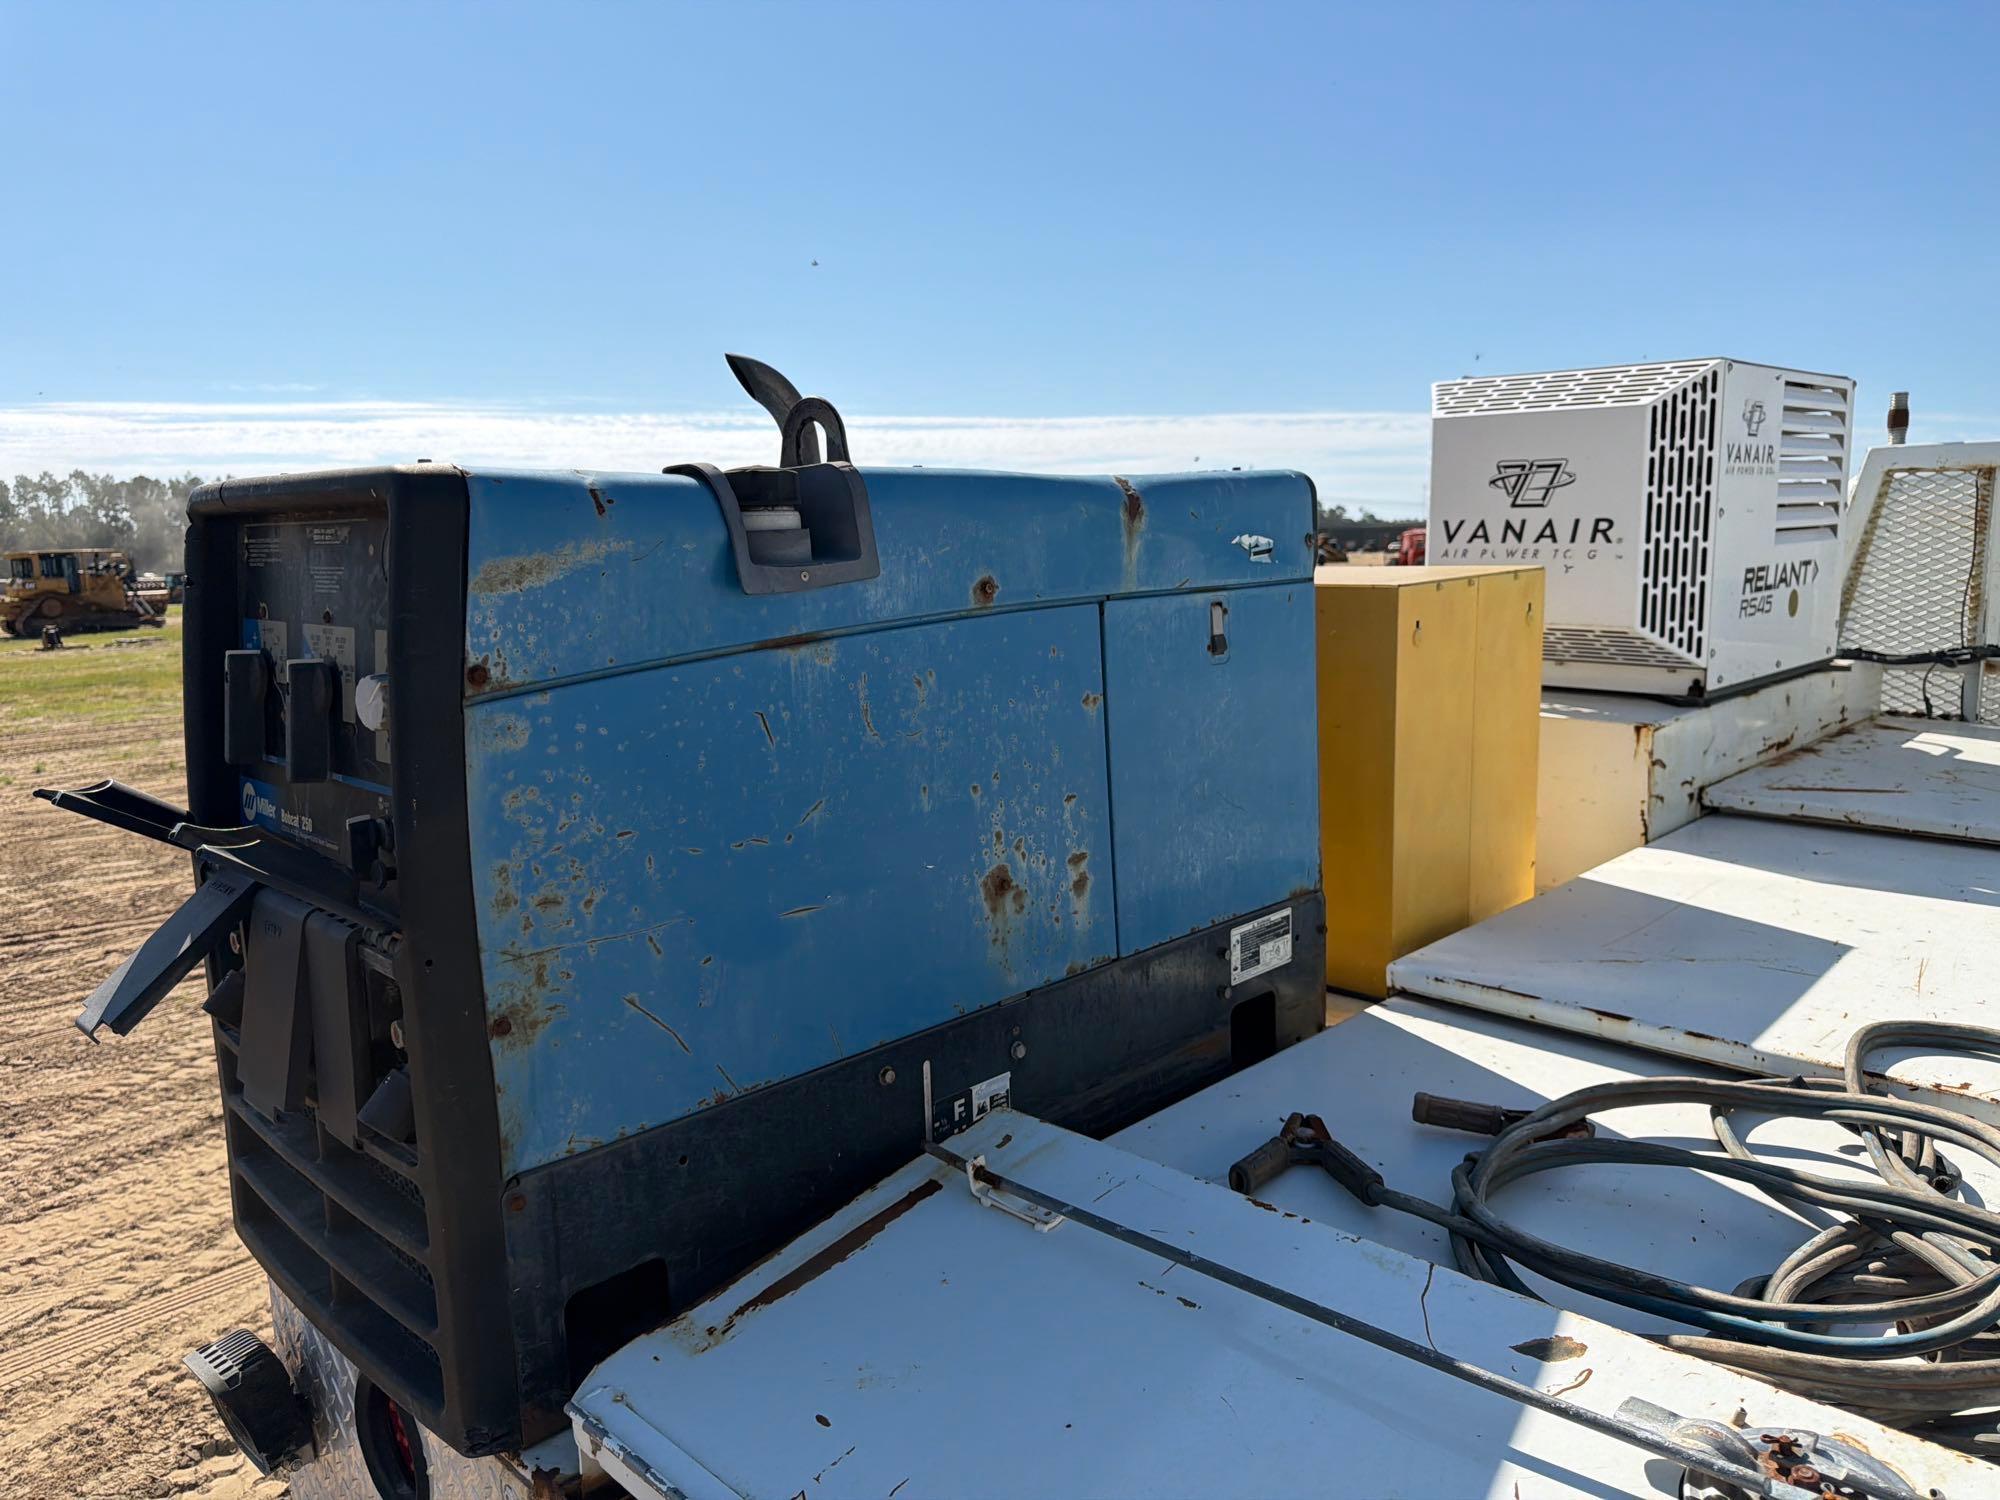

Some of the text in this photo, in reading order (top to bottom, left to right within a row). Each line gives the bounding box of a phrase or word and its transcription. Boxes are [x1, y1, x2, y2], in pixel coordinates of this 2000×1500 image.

[1727, 443, 1774, 465] VANAIR
[1443, 518, 1615, 544] VANAIR
[1441, 548, 1470, 560] AIR
[1739, 594, 1773, 619] RS45
[257, 795, 277, 819] Miller
[281, 807, 300, 828] Bobcat
